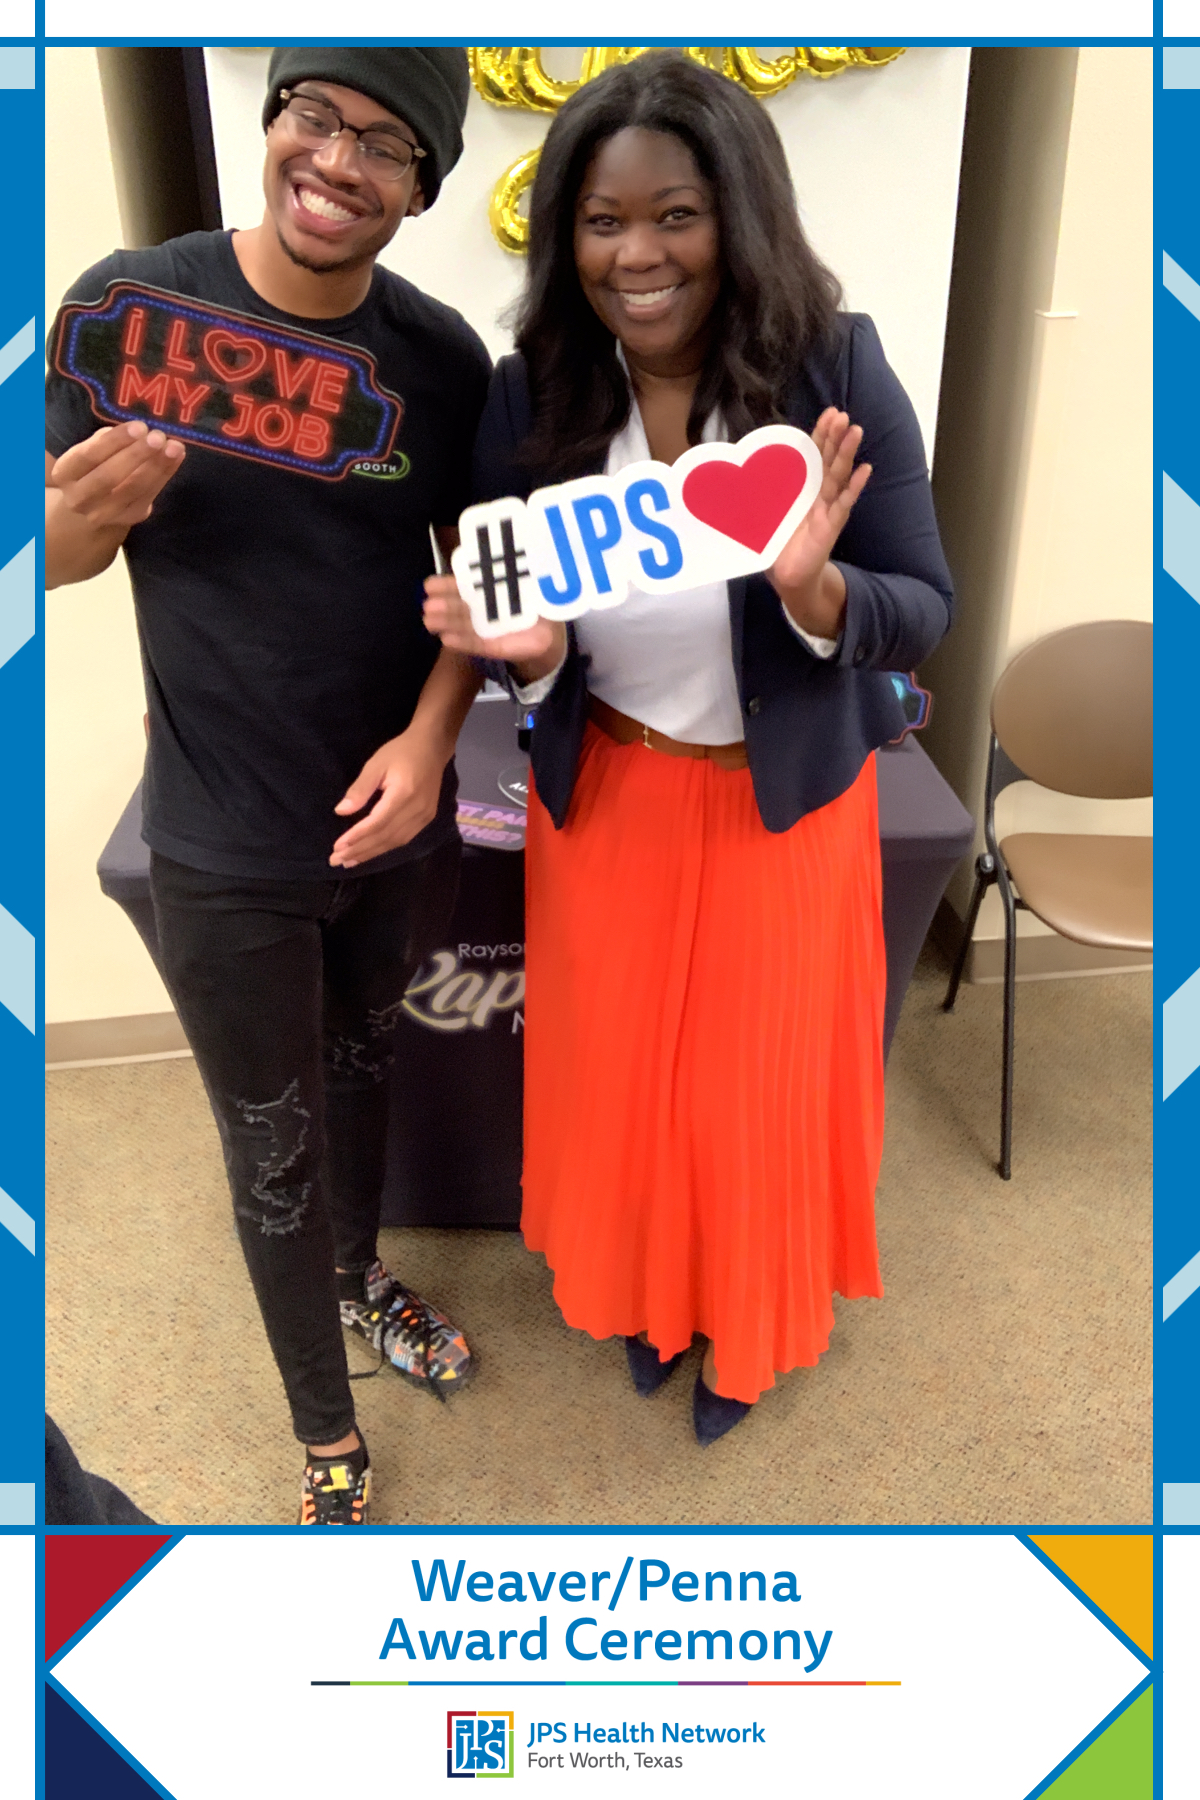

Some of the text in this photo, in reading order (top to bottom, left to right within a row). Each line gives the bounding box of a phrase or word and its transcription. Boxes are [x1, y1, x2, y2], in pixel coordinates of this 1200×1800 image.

[124, 307, 144, 356] I
[117, 363, 331, 459] MY JOB
[457, 942, 525, 960] Rayso
